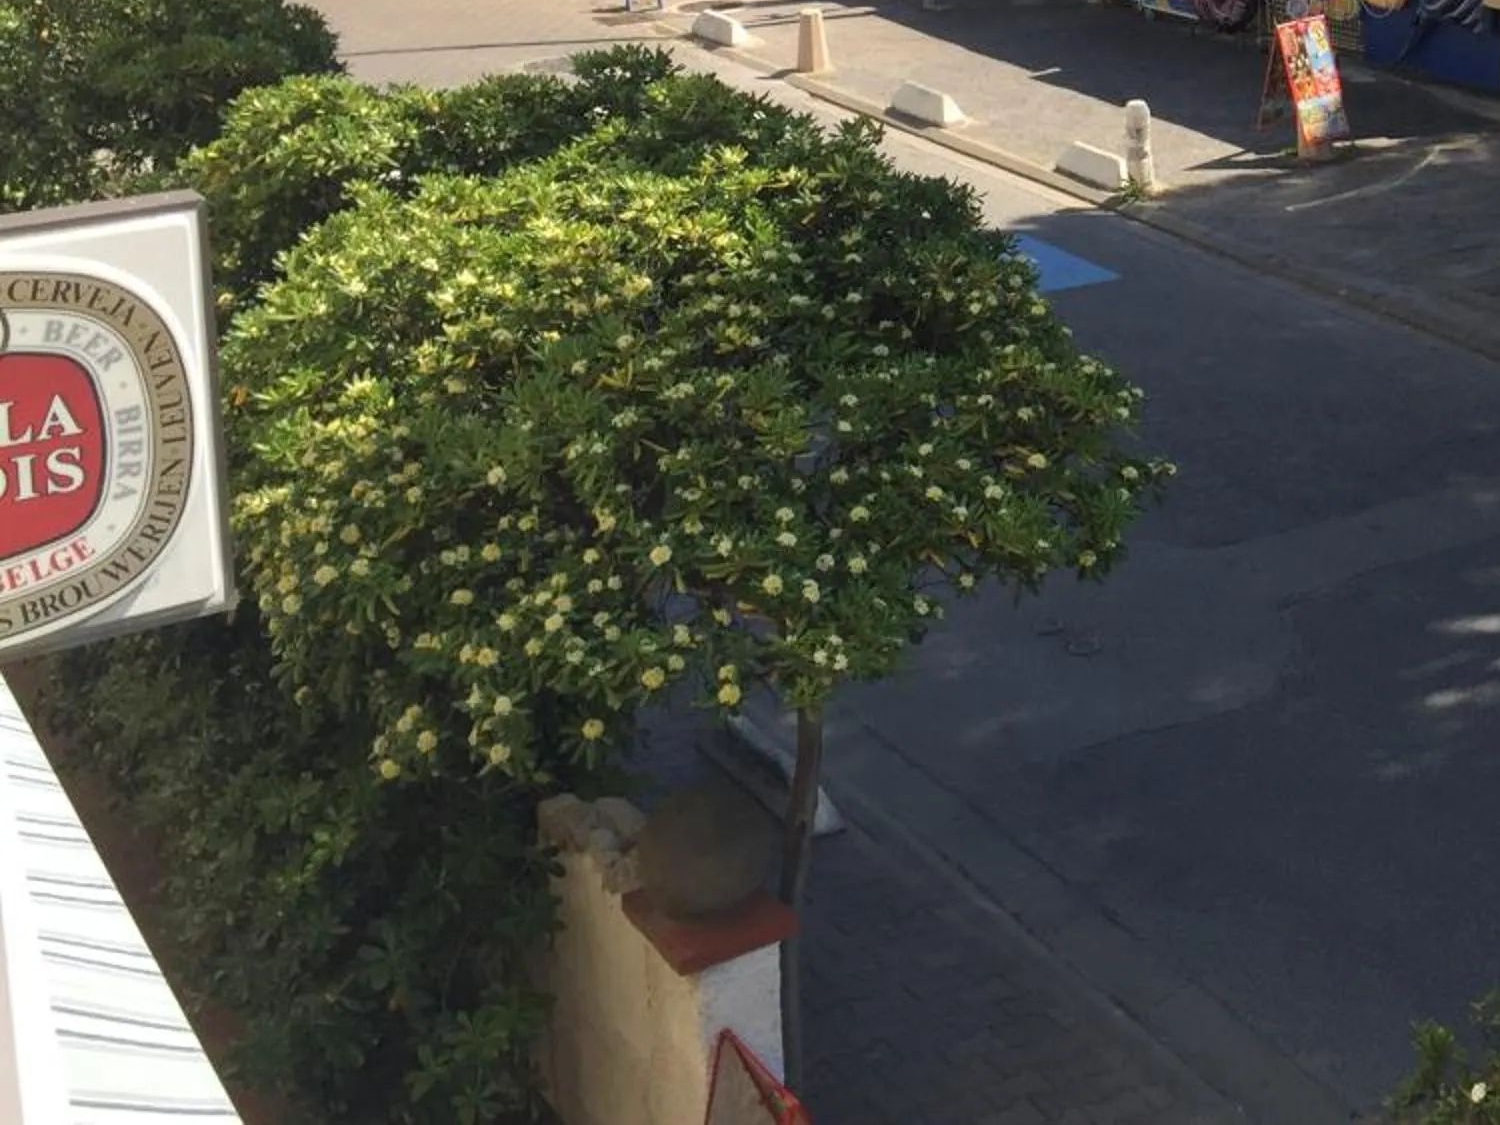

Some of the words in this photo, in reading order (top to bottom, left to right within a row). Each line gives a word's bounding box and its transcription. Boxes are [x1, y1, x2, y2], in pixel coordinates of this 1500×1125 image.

[7, 278, 137, 328] CERVEJA
[43, 320, 124, 373] BEER
[144, 331, 188, 445] LEUVEN
[112, 404, 144, 502] BIRRA
[19, 458, 187, 625] BROUWERIJEN
